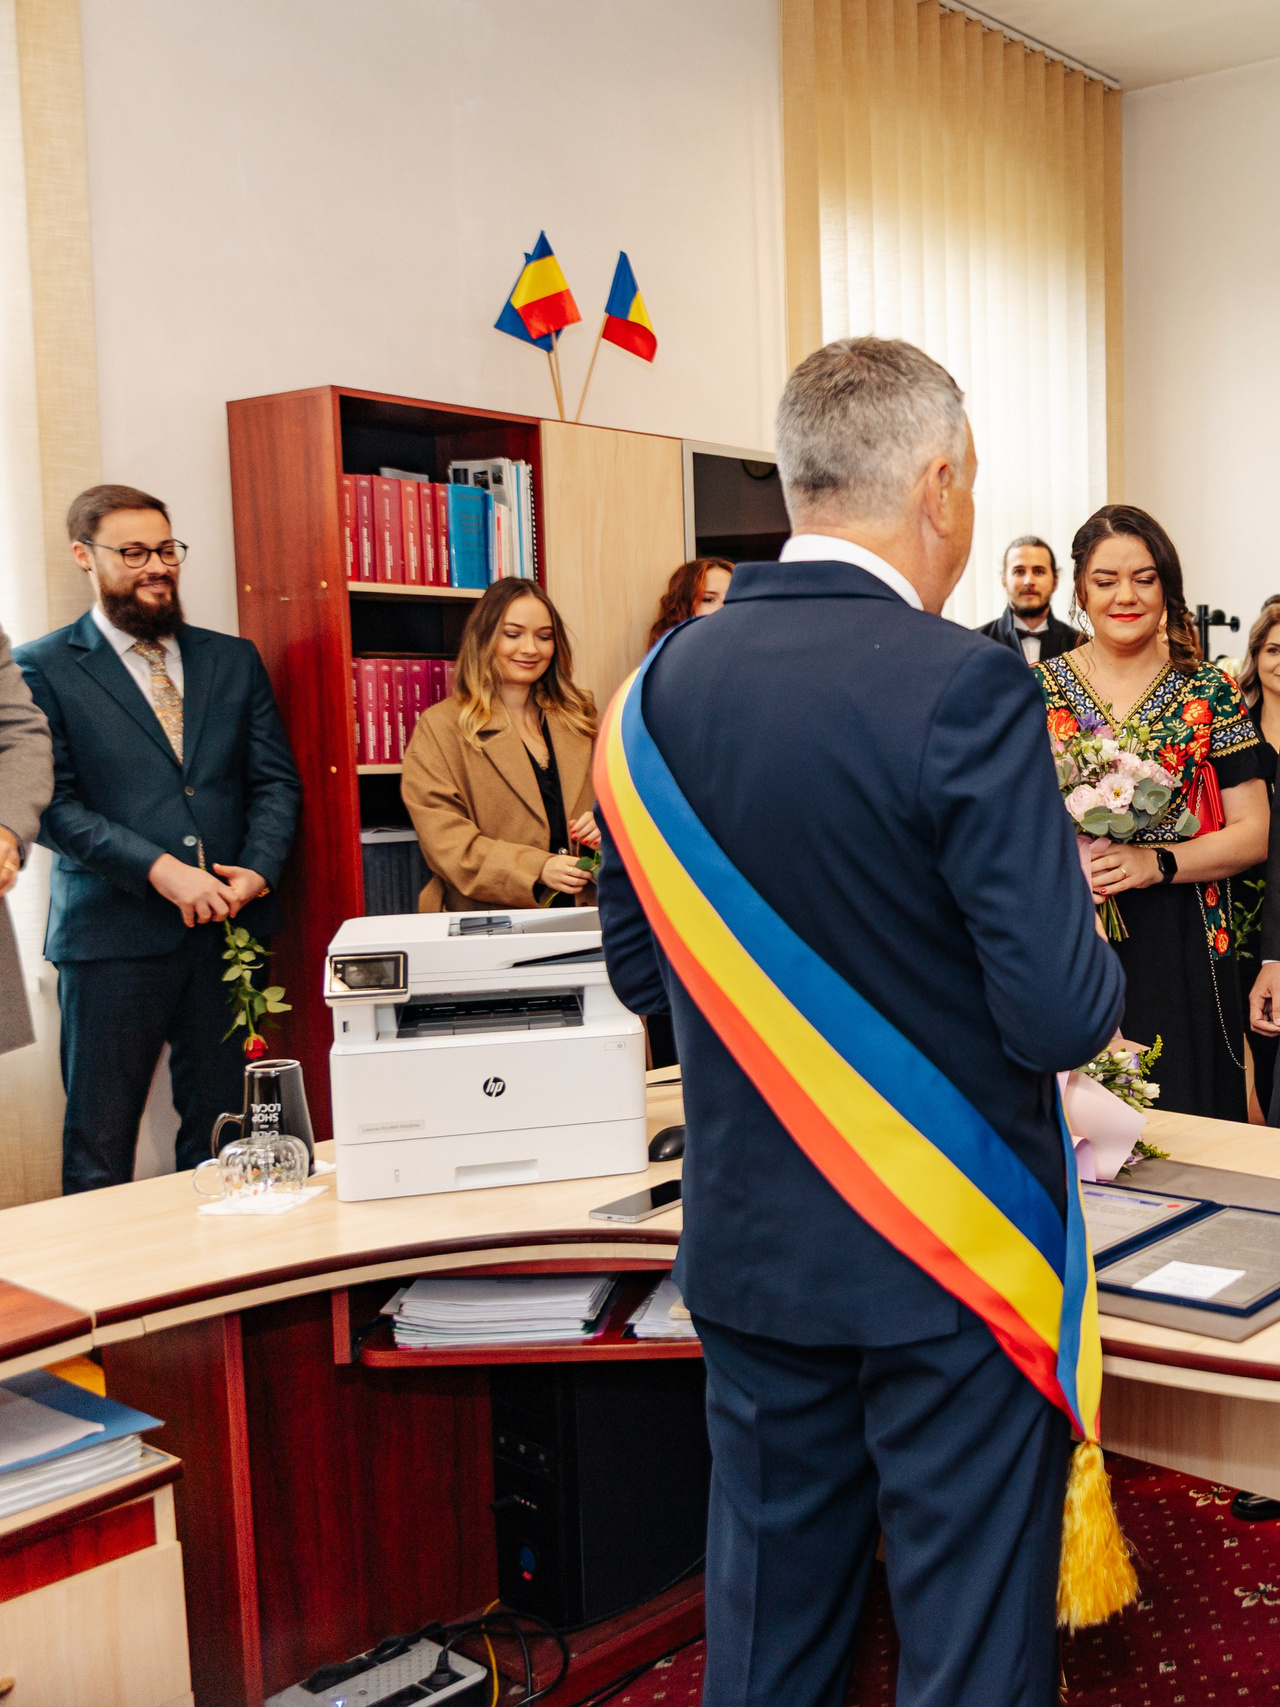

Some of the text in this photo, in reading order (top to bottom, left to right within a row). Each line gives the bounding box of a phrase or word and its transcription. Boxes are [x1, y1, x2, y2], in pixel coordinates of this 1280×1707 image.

[485, 1076, 504, 1098] hp
[250, 1103, 281, 1113] LOCAL
[251, 1112, 279, 1123] SHOP
